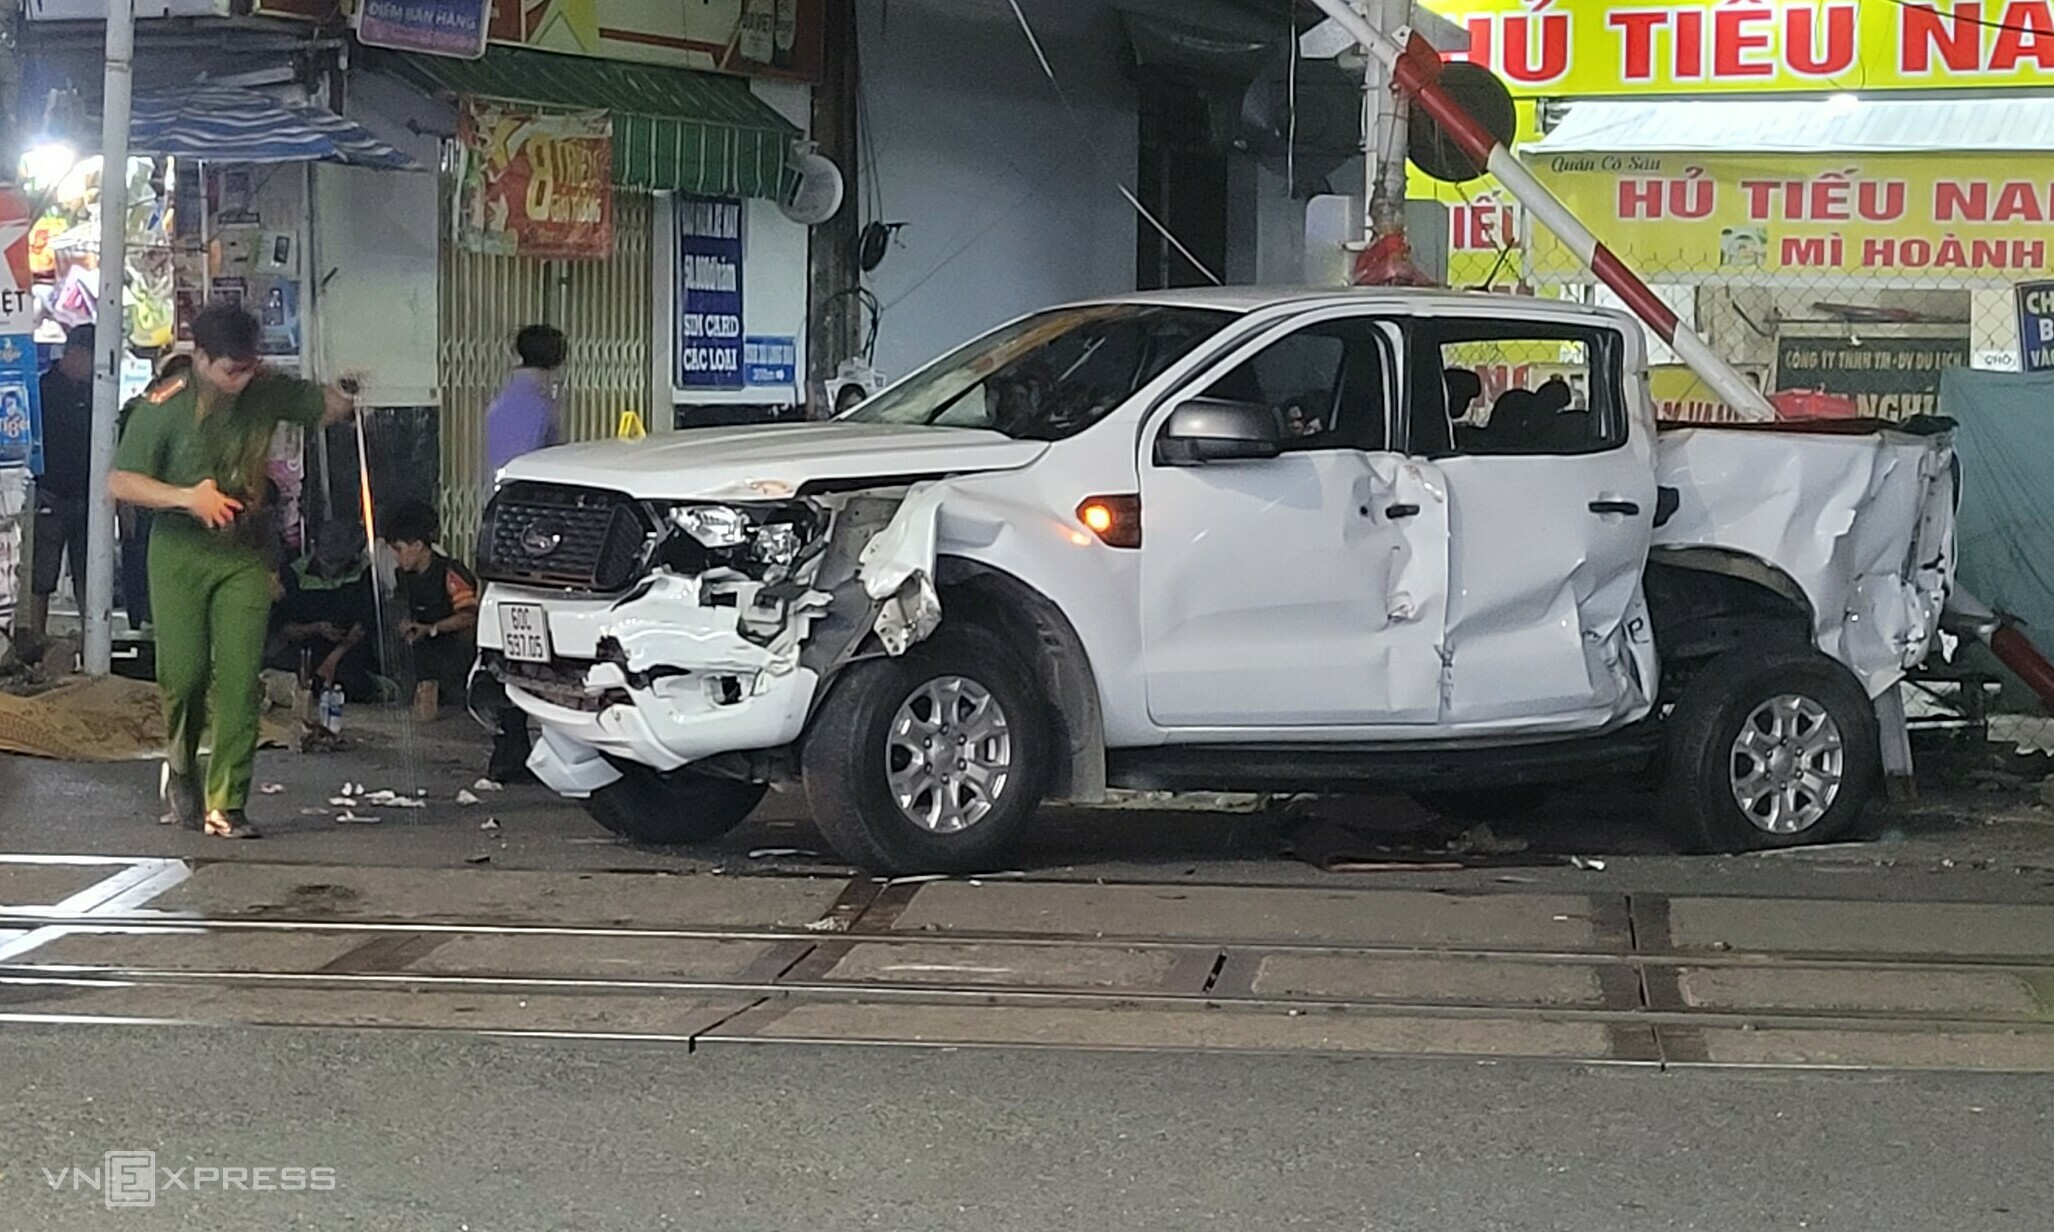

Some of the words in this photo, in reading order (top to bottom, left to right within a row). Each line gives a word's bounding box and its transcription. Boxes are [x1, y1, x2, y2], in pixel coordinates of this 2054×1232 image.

[1619, 166, 1713, 218] HỦ
[1741, 168, 1906, 221] TIẾU
[1935, 182, 2054, 221] NA
[1781, 232, 1843, 267] MÌ
[1864, 232, 2045, 268] HOÀNH
[684, 313, 704, 337] SIM
[704, 314, 740, 338] CARD
[683, 342, 708, 371] CÁC
[709, 347, 738, 378] LOẠI
